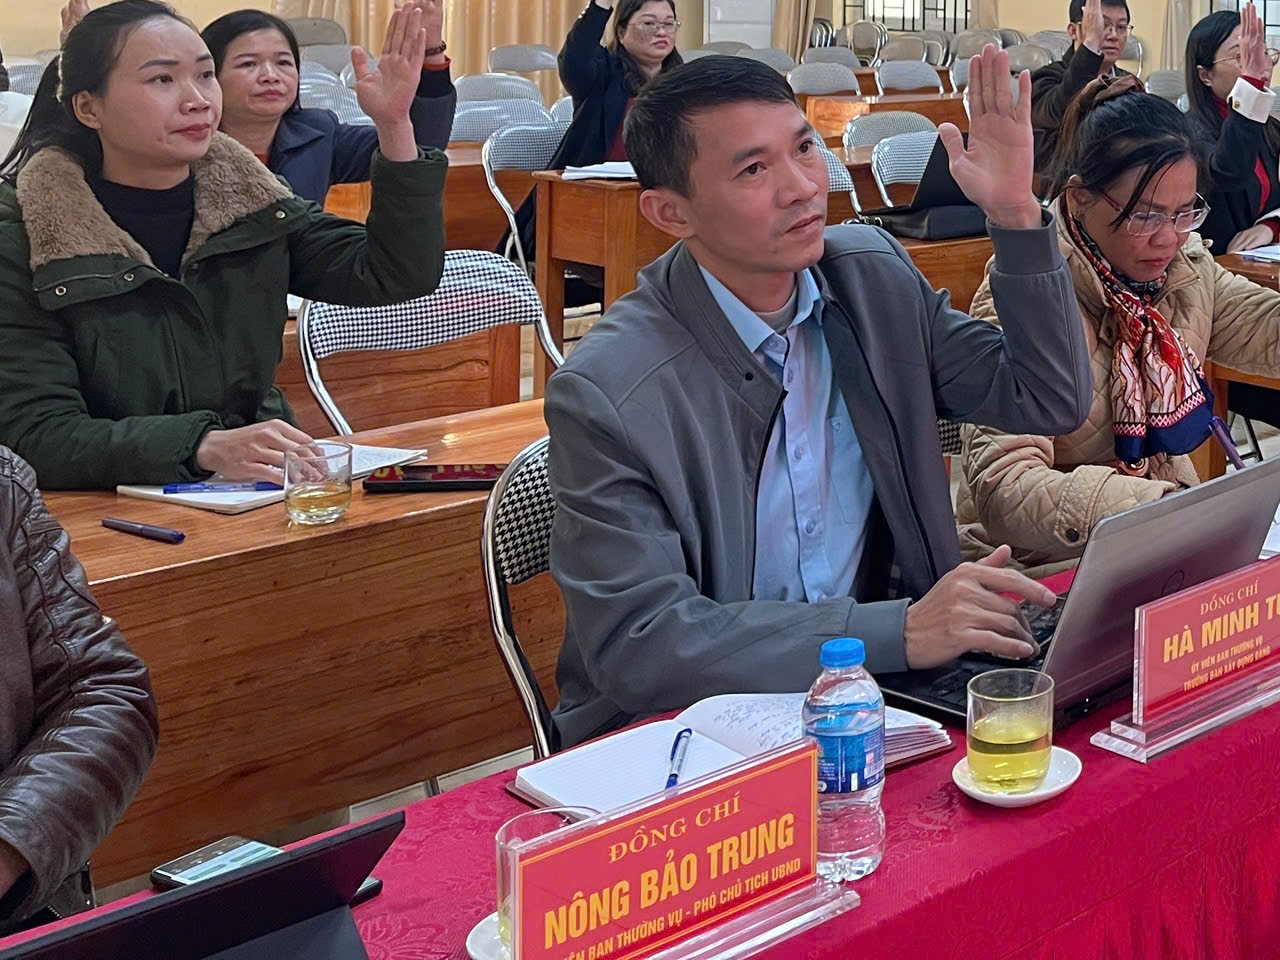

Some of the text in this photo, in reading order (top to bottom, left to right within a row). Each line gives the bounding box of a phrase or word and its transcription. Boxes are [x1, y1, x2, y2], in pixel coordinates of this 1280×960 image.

[1237, 579, 1259, 600] CHÍ
[1163, 625, 1195, 664] HÀ
[1201, 601, 1260, 649] MINH
[608, 791, 743, 863] ĐỒNG CHÍ
[544, 812, 795, 950] NÔNG BẢO TRUNG
[588, 937, 614, 960] BAN
[616, 913, 665, 949] THƯỜNG
[668, 907, 684, 928] VỤ
[694, 891, 717, 916] PHÓ
[719, 882, 742, 905] CHỦ
[746, 872, 769, 897] TỊCH
[771, 857, 801, 881] UBND
